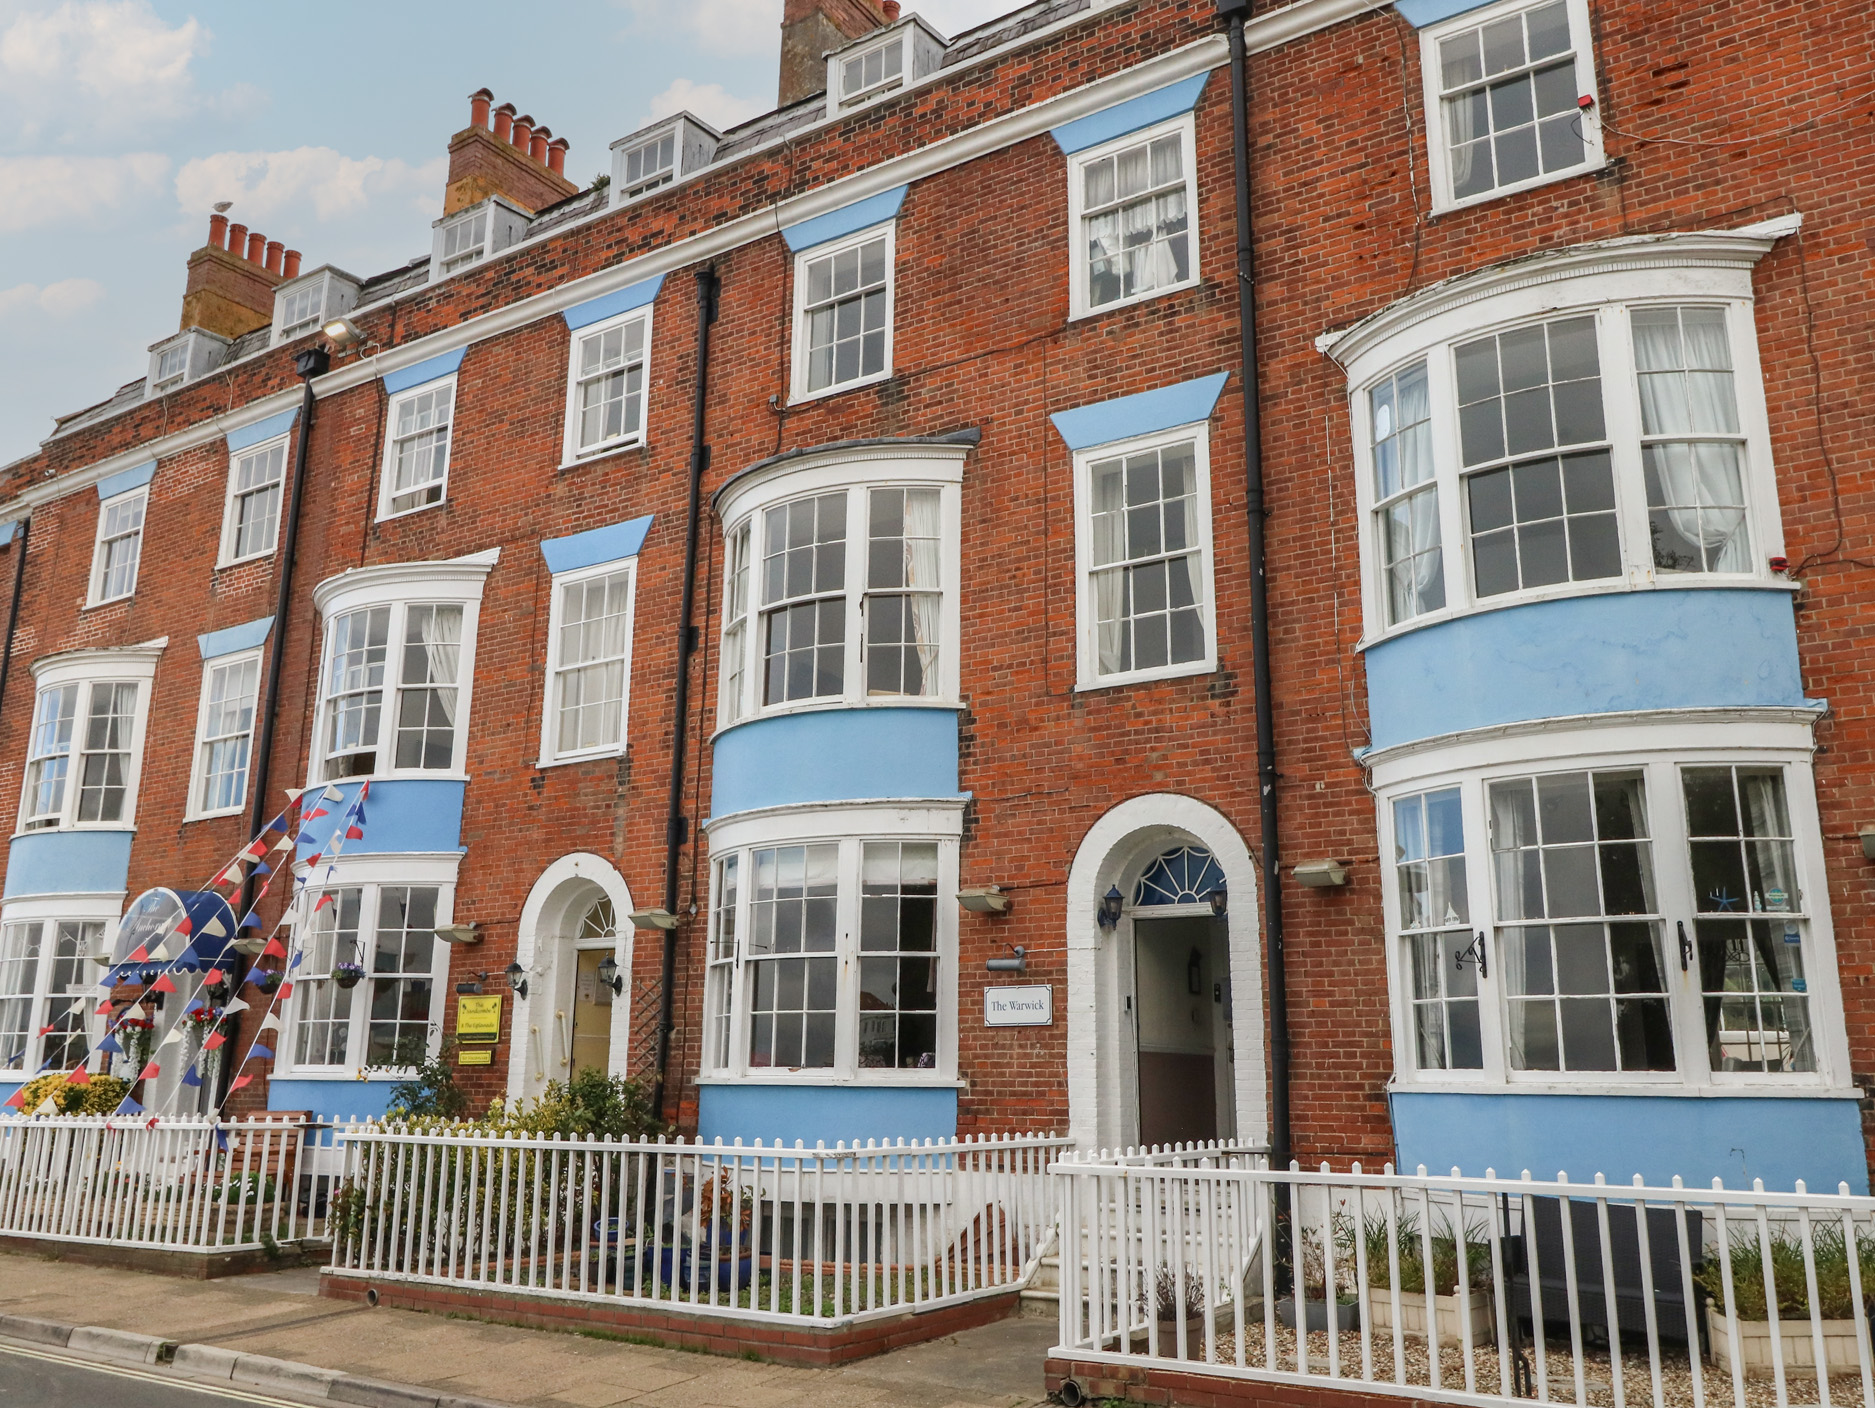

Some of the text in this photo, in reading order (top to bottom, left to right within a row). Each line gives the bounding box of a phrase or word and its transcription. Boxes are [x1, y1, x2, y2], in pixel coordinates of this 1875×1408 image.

[143, 897, 160, 914] The
[991, 1000, 1044, 1011] The Warwick
